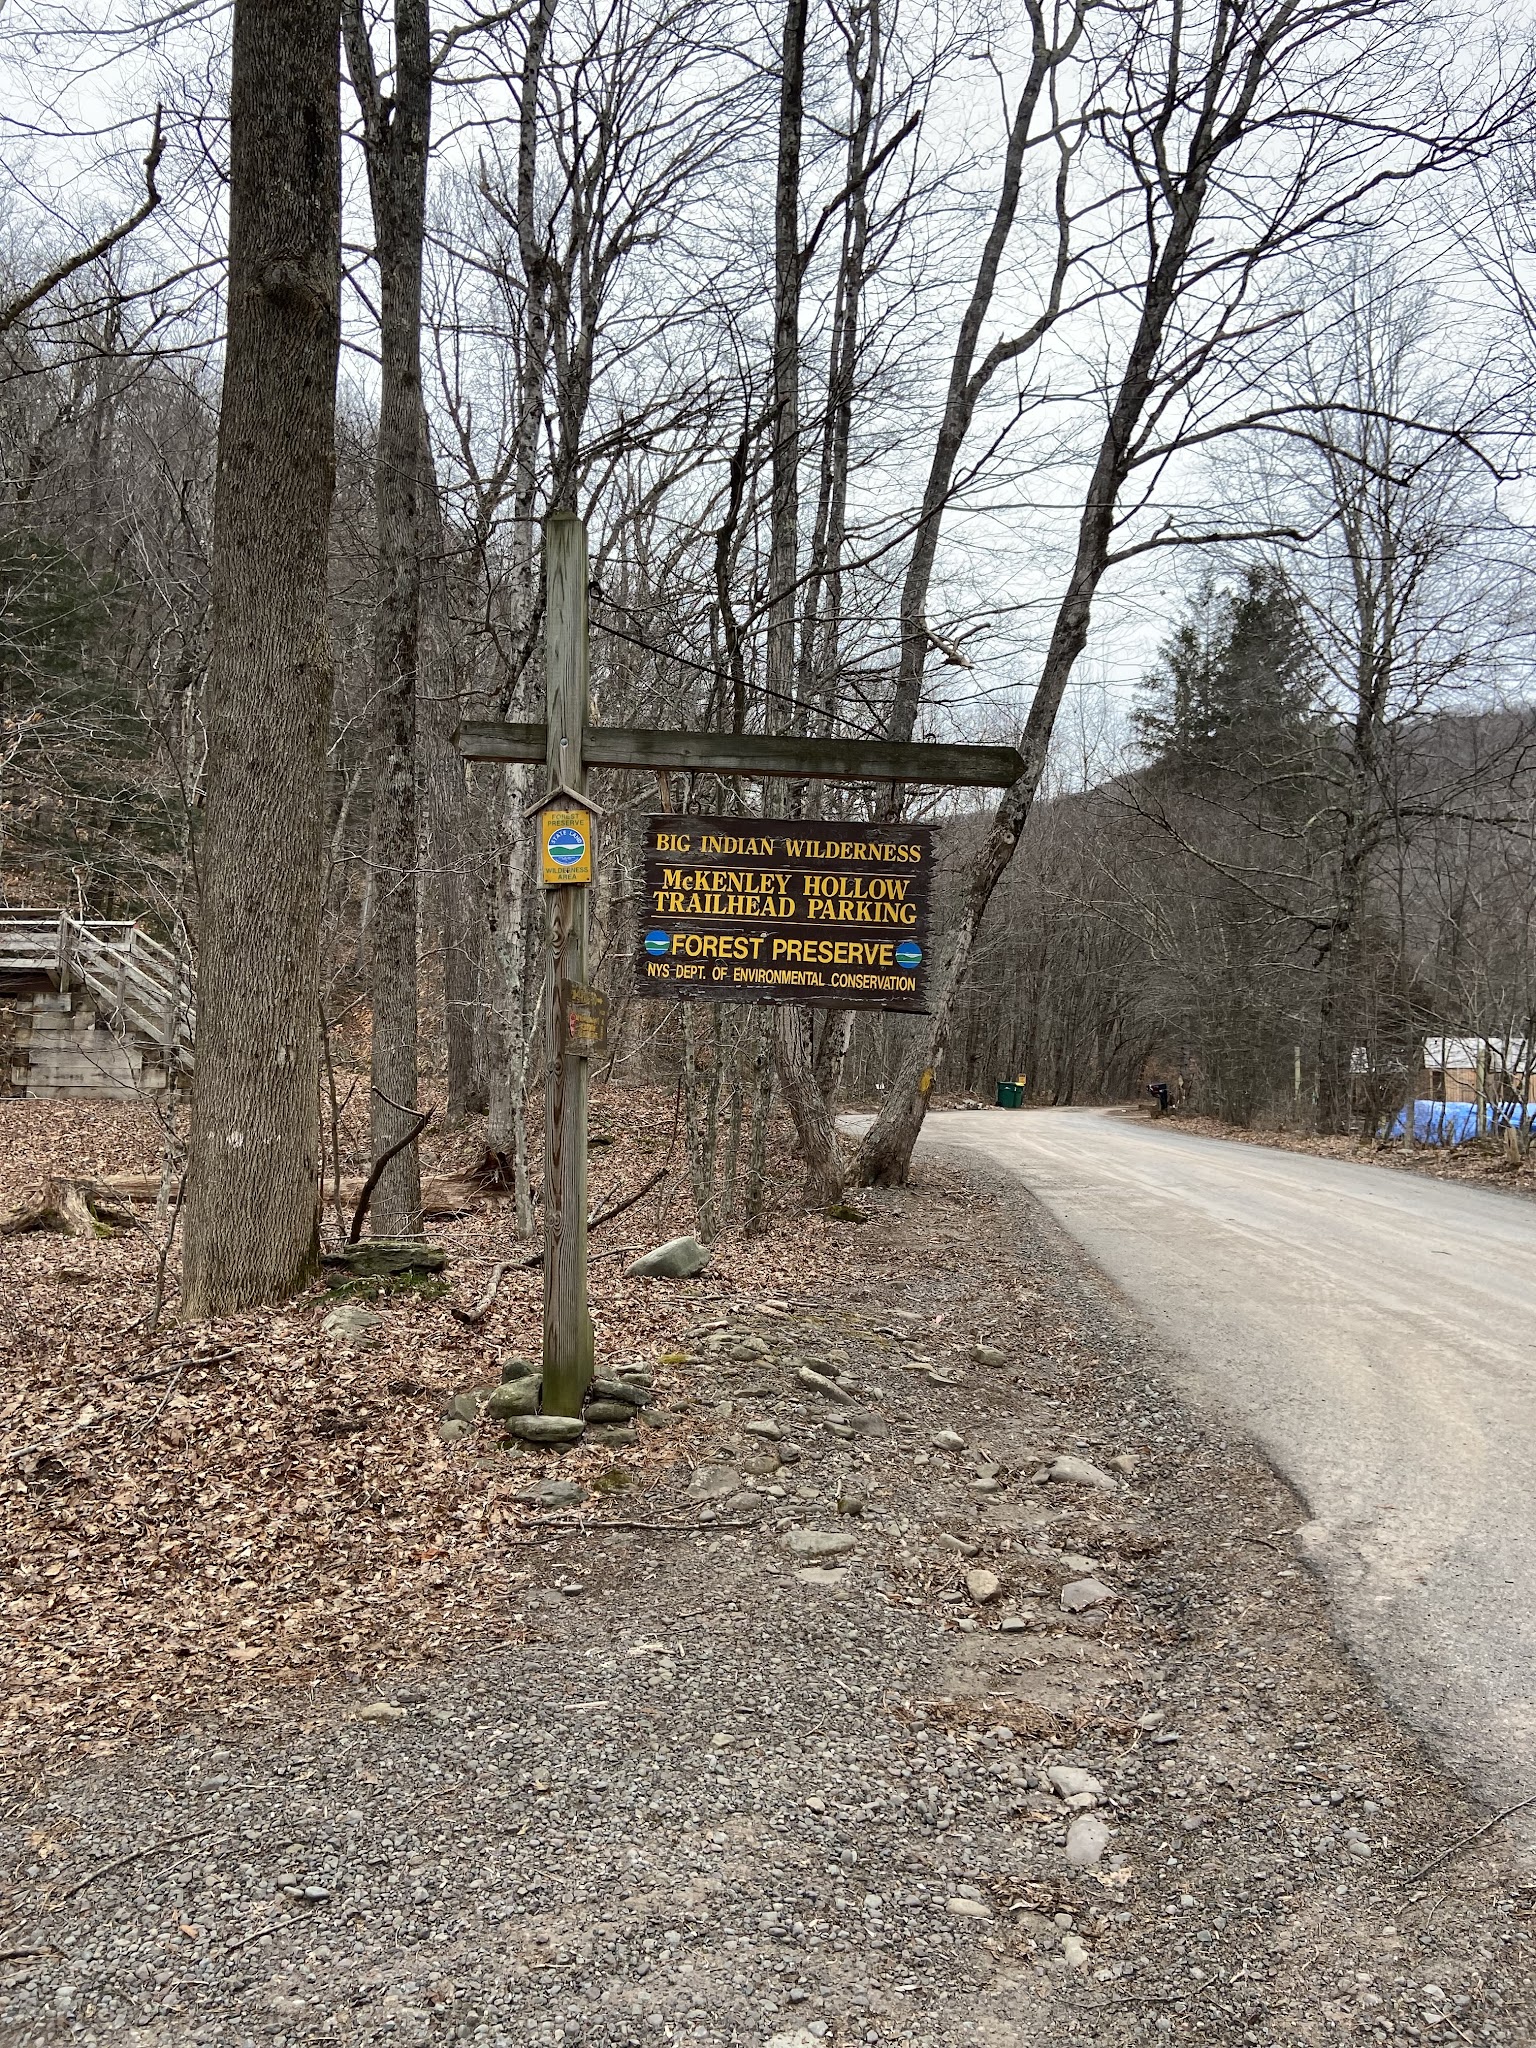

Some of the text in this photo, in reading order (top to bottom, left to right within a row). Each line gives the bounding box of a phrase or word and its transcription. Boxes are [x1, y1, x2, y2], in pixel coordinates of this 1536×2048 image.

[551, 830, 582, 844] STATE LAND
[656, 833, 922, 863] BIG INDIAN WILDERNESS
[662, 868, 910, 901] McKENLEY HOLLOW
[653, 891, 917, 924] TRAILHEAD PARKING
[672, 933, 894, 966] FOREST PRESERVE
[647, 963, 916, 991] NYS DEPT. OF ENVIRONMENTAL CONSERVATION
